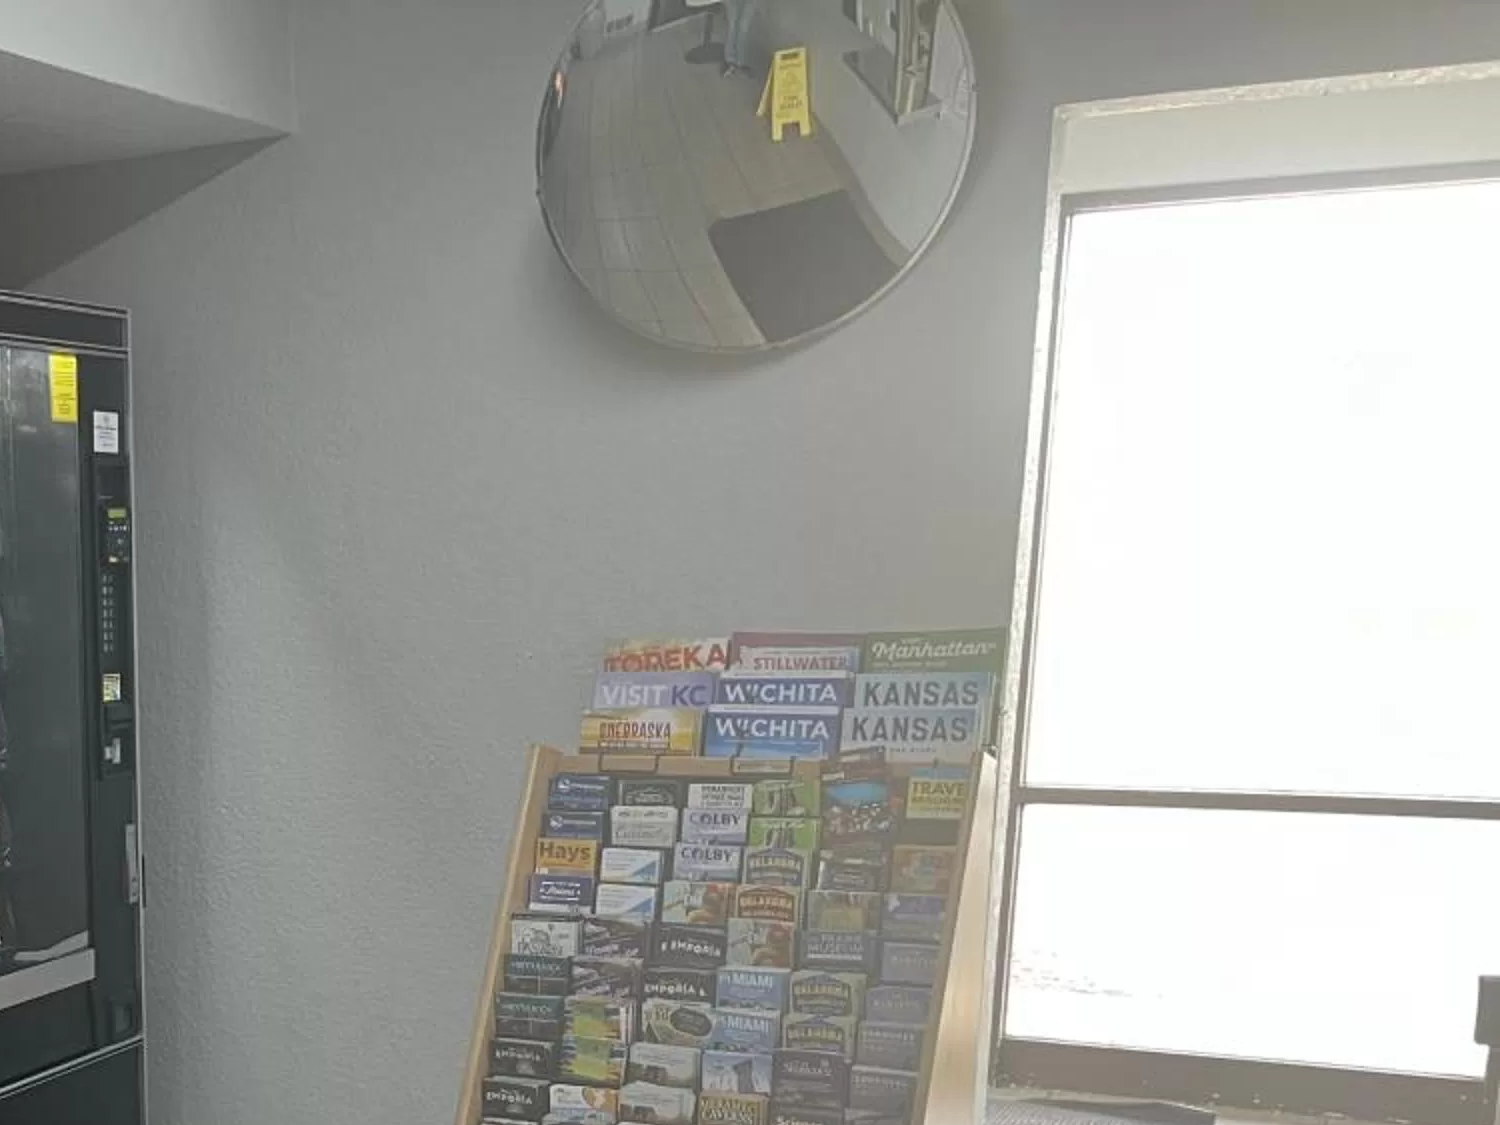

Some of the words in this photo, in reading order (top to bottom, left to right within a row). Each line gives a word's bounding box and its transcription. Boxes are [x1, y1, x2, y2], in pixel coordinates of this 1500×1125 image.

[601, 684, 667, 707] VISIT
[671, 684, 708, 707] KC
[863, 680, 979, 707] KANSAS
[851, 715, 968, 742] KANSAS
[539, 841, 591, 864] Hays
